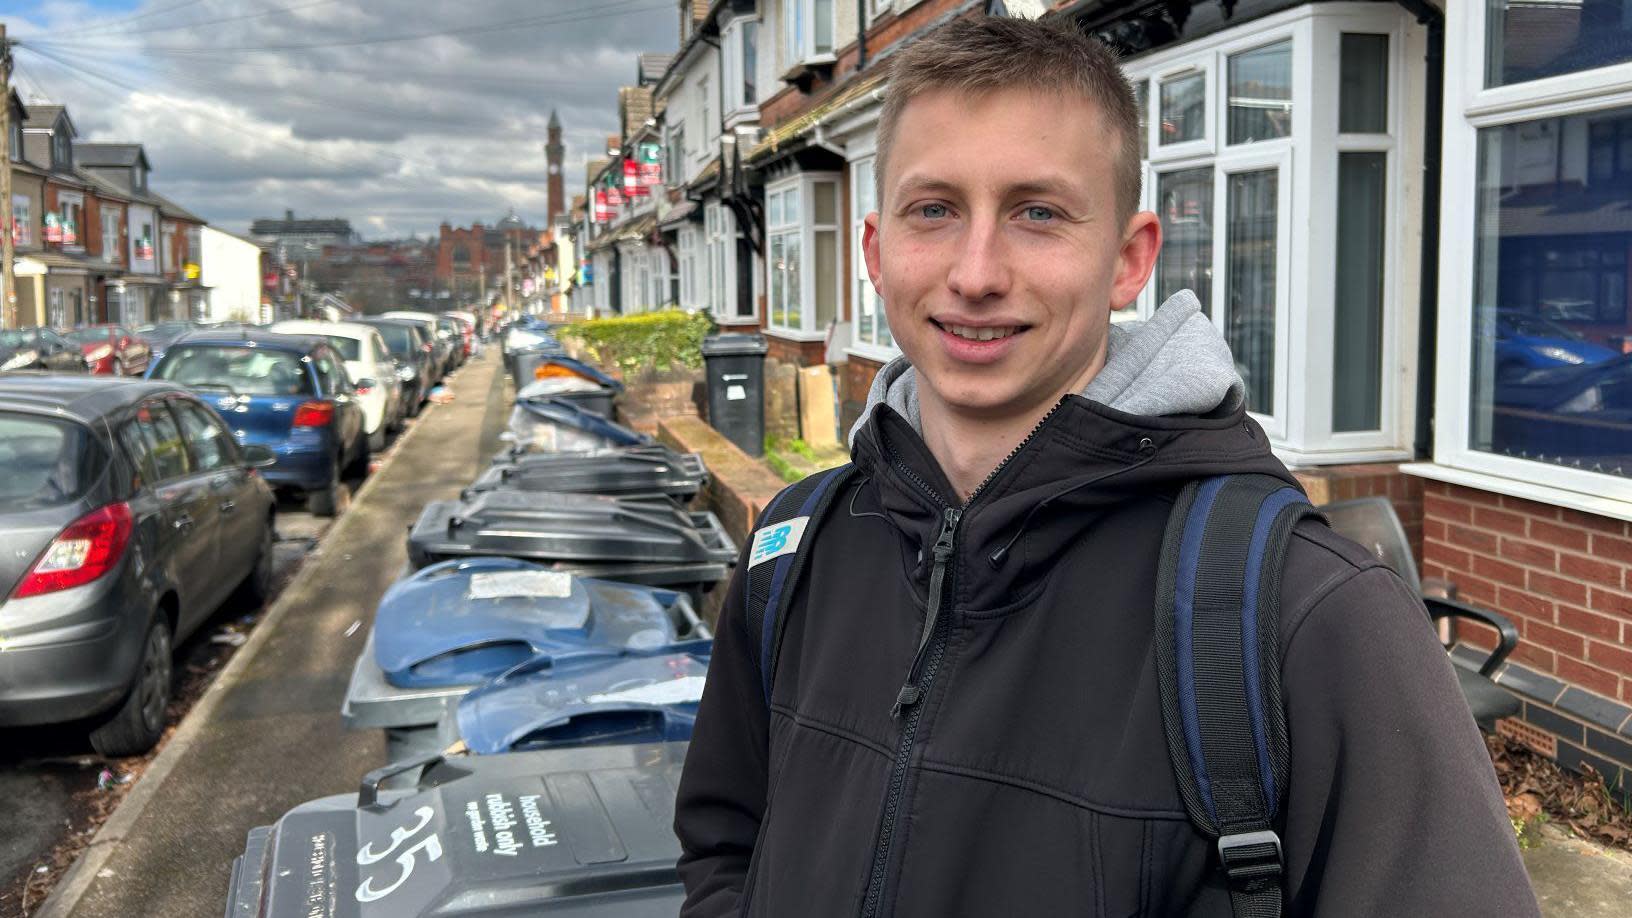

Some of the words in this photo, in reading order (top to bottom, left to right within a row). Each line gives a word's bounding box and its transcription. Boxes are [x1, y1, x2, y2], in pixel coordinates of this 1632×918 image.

[465, 810, 486, 831] garden
[486, 793, 518, 830] rubbish
[519, 794, 558, 847] household
[355, 805, 443, 902] 35
[473, 831, 489, 852] waste
[493, 831, 524, 855] only
